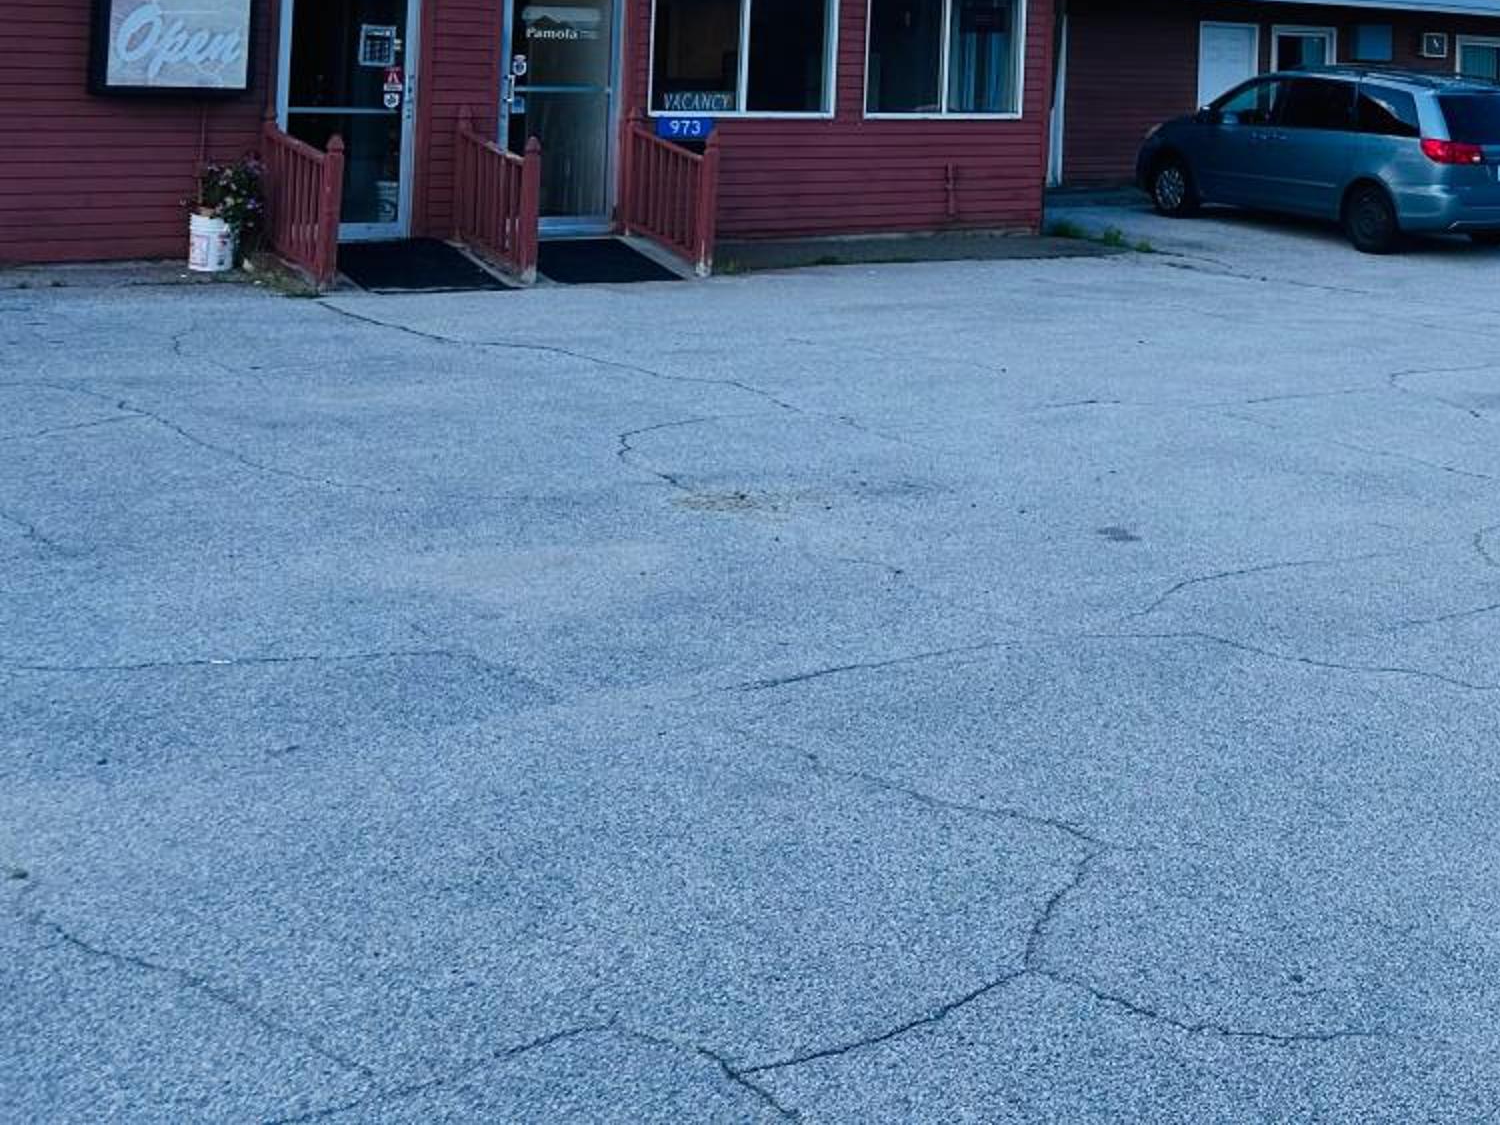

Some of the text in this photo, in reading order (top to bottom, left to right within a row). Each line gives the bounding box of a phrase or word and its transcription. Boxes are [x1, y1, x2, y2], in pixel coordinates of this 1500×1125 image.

[115, 3, 242, 78] Open
[525, 27, 578, 41] Pamola
[663, 92, 732, 110] VACANCY
[669, 119, 702, 136] 973
